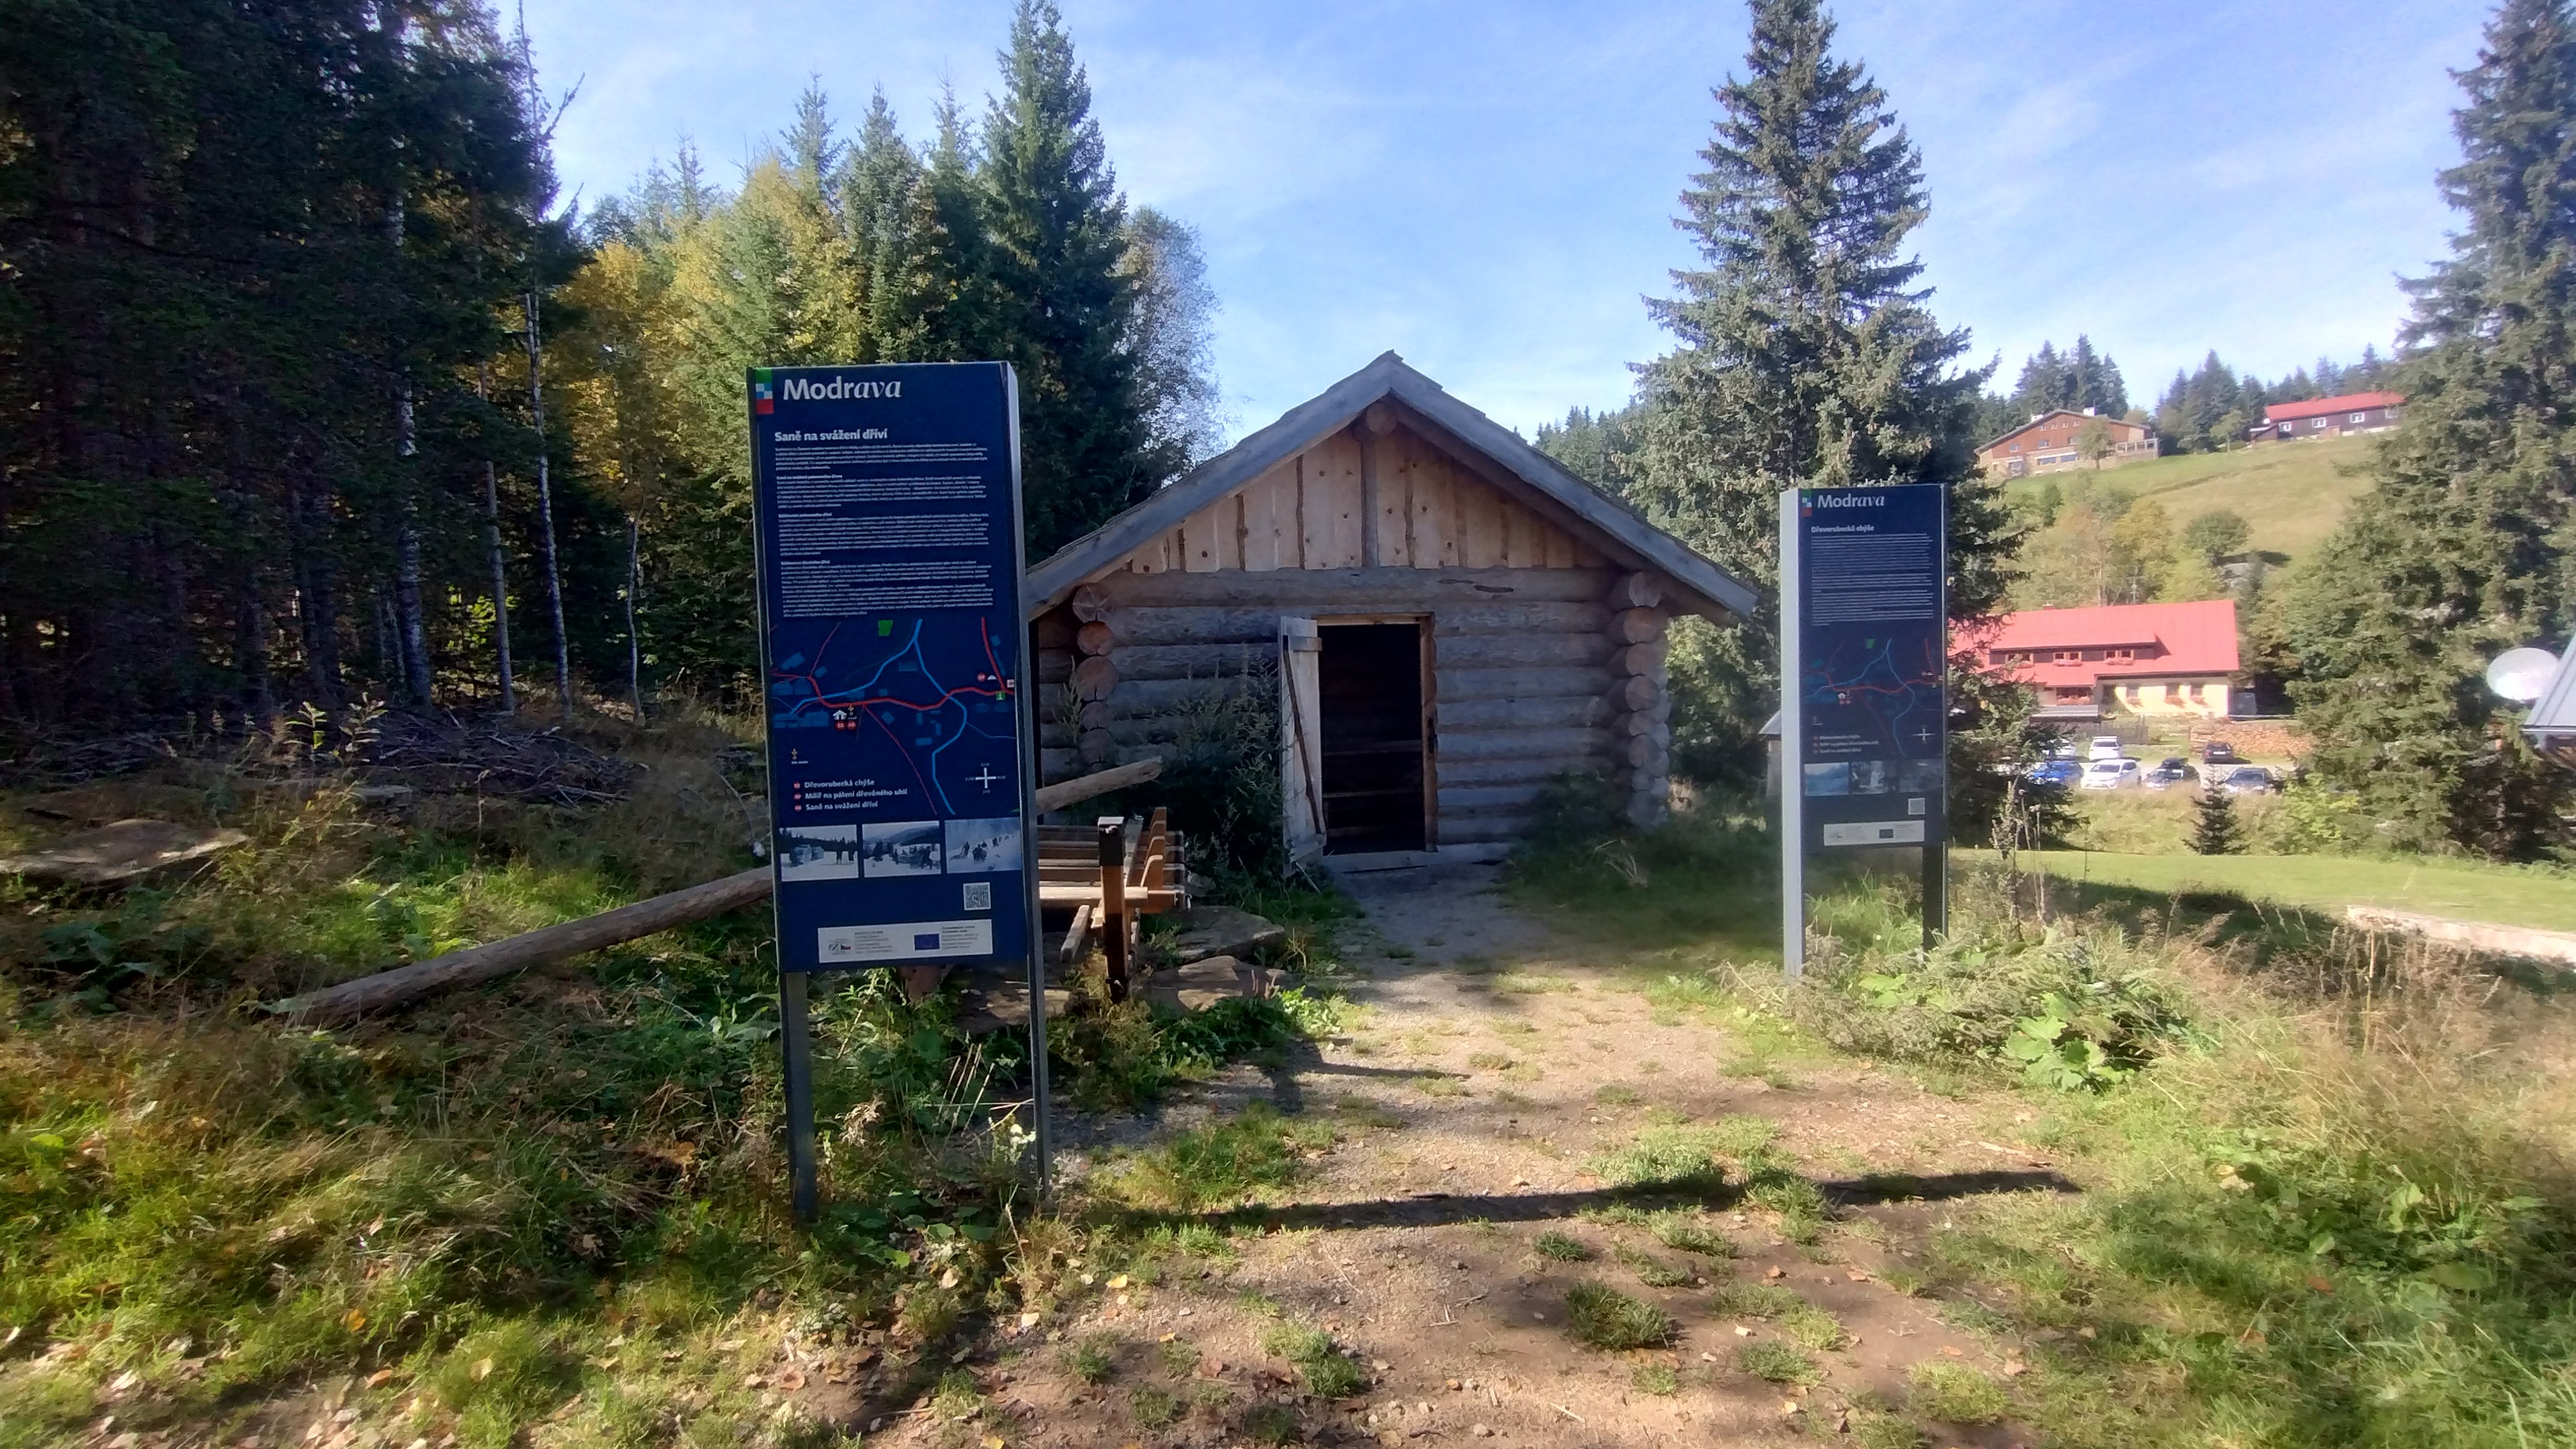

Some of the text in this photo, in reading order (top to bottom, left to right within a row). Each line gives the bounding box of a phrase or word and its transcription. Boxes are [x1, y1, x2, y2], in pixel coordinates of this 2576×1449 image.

[783, 376, 902, 400] Modrava
[774, 428, 888, 442] Saně na svážení dříví
[1817, 492, 1885, 508] Modrava
[804, 779, 853, 788] Dřevorubecká
[854, 779, 875, 788] chýše
[833, 790, 855, 799] pálení
